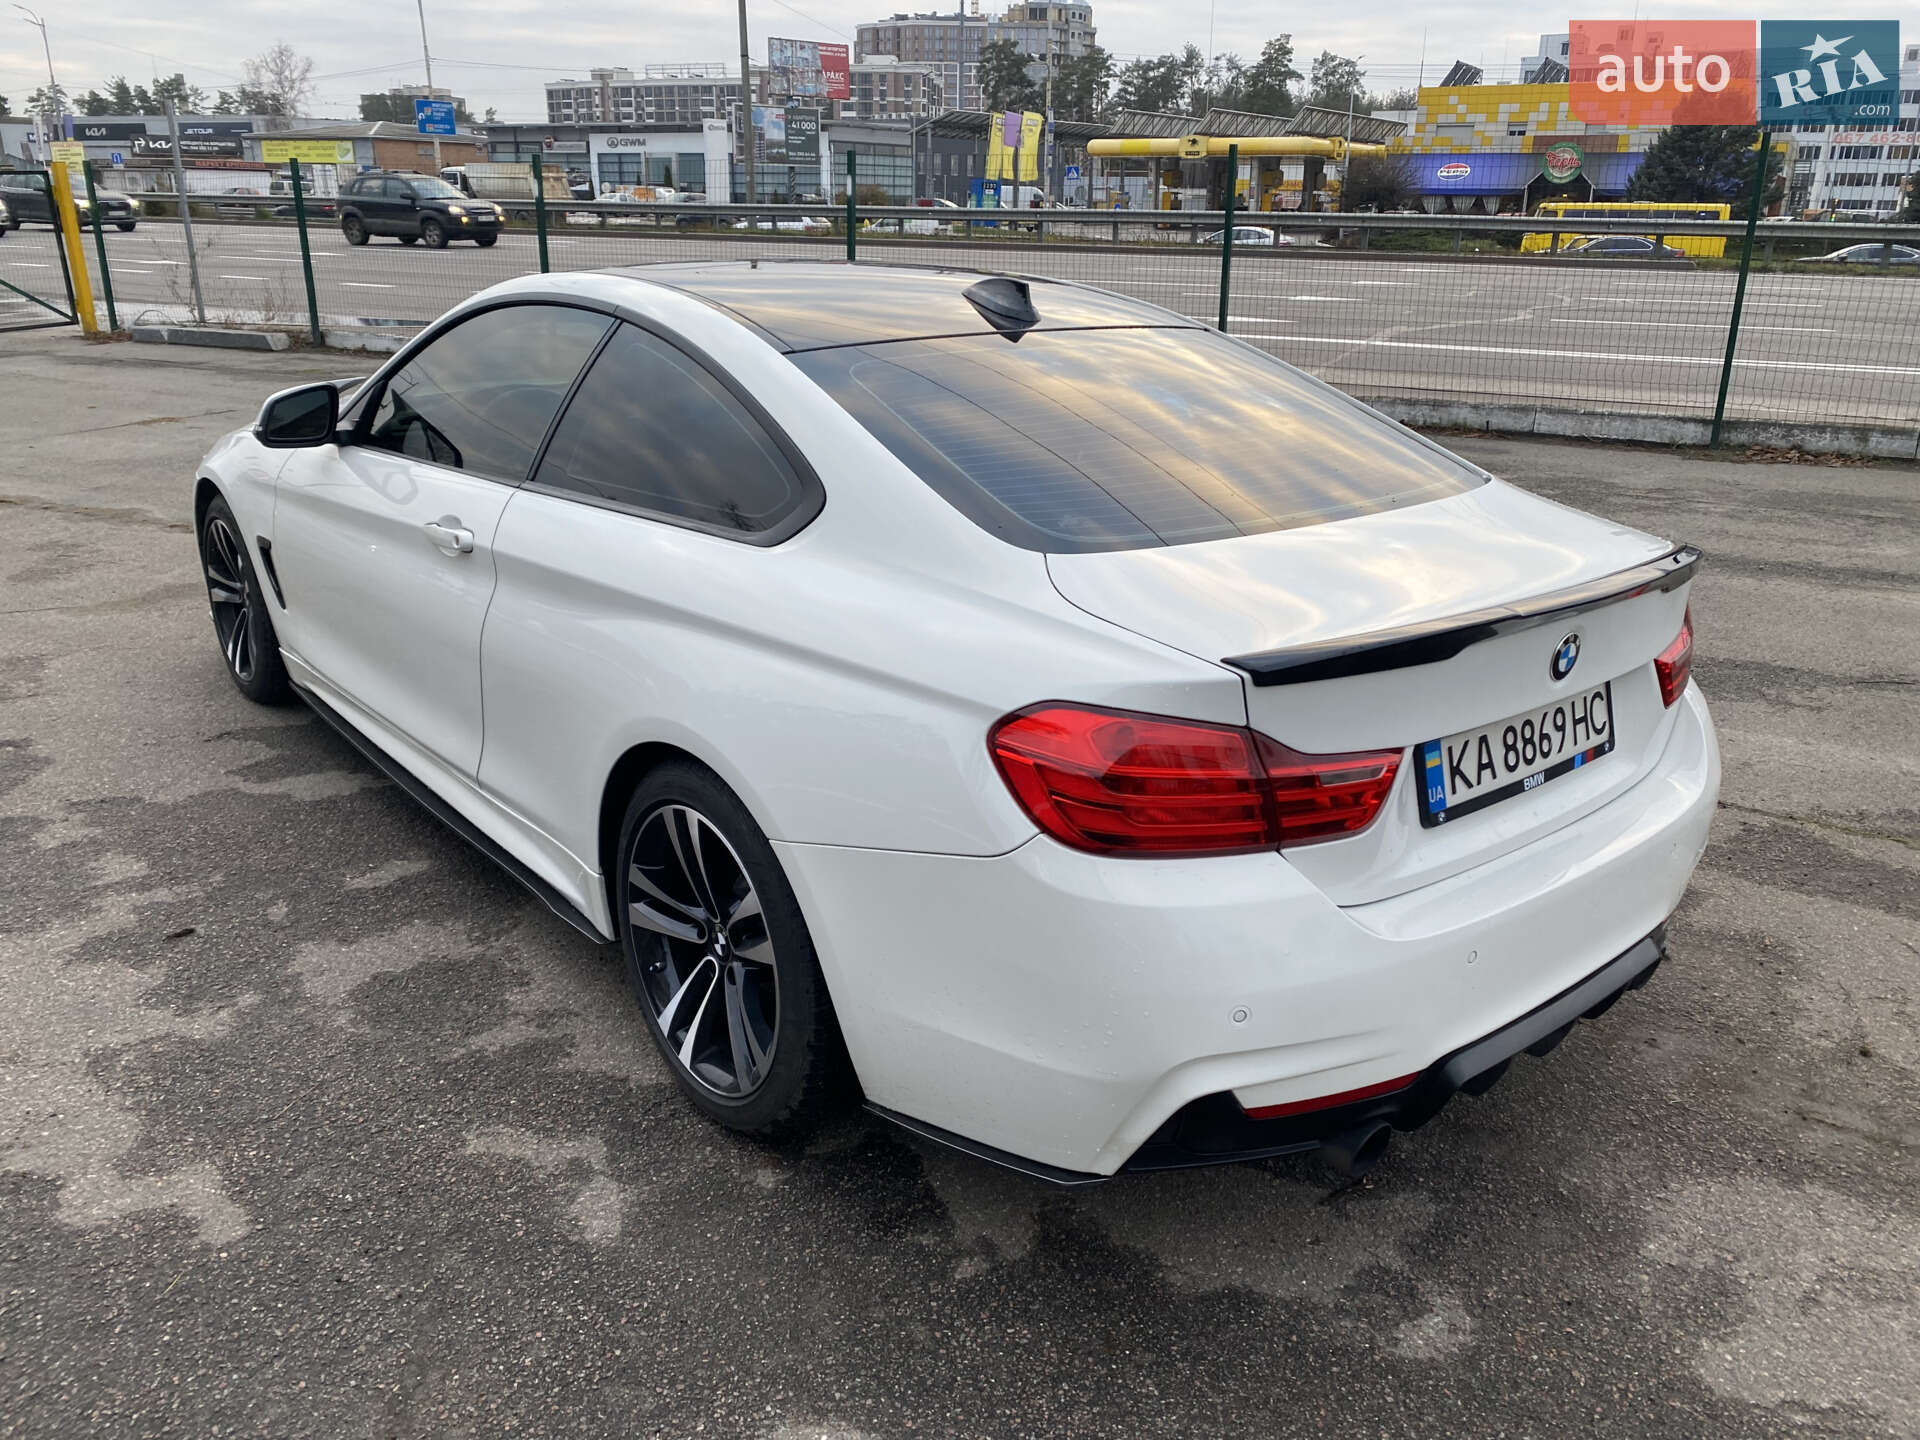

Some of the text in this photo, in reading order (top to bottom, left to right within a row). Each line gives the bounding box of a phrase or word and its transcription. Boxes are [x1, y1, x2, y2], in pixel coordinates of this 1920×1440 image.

[620, 138, 646, 147] GWM
[1523, 771, 1545, 791] BMW
[1428, 785, 1445, 804] UA
